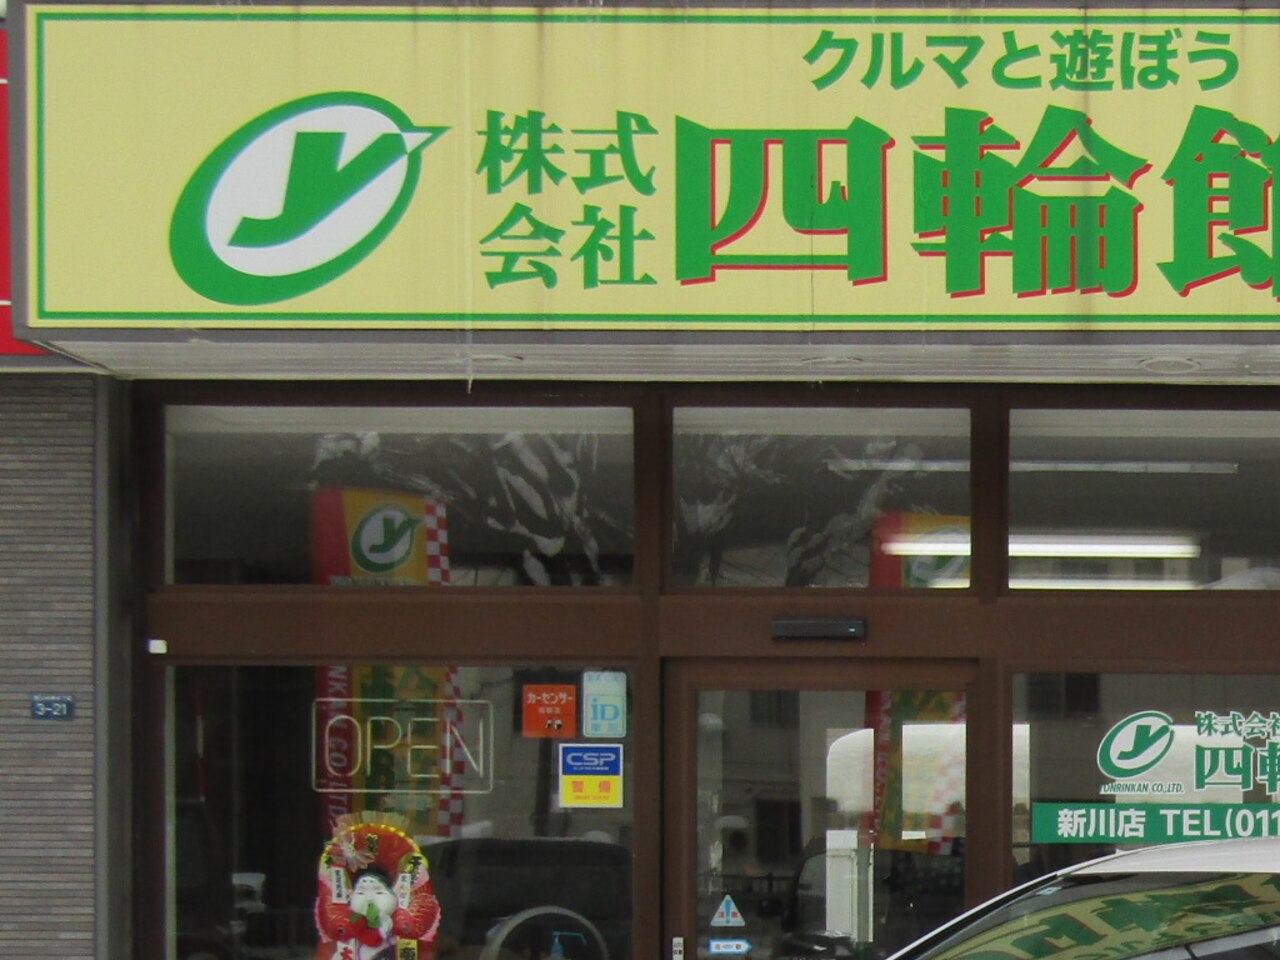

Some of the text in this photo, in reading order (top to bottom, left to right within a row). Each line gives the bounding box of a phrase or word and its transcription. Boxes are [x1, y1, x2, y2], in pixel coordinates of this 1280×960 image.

[803, 29, 1241, 91] クルマと遊ぼう
[477, 109, 660, 197] 株式
[478, 203, 660, 290] 会社
[527, 690, 575, 705] カーセンサー
[325, 714, 484, 778] OPEN
[566, 752, 616, 766] CSP
[1057, 808, 1146, 838] 新川店
